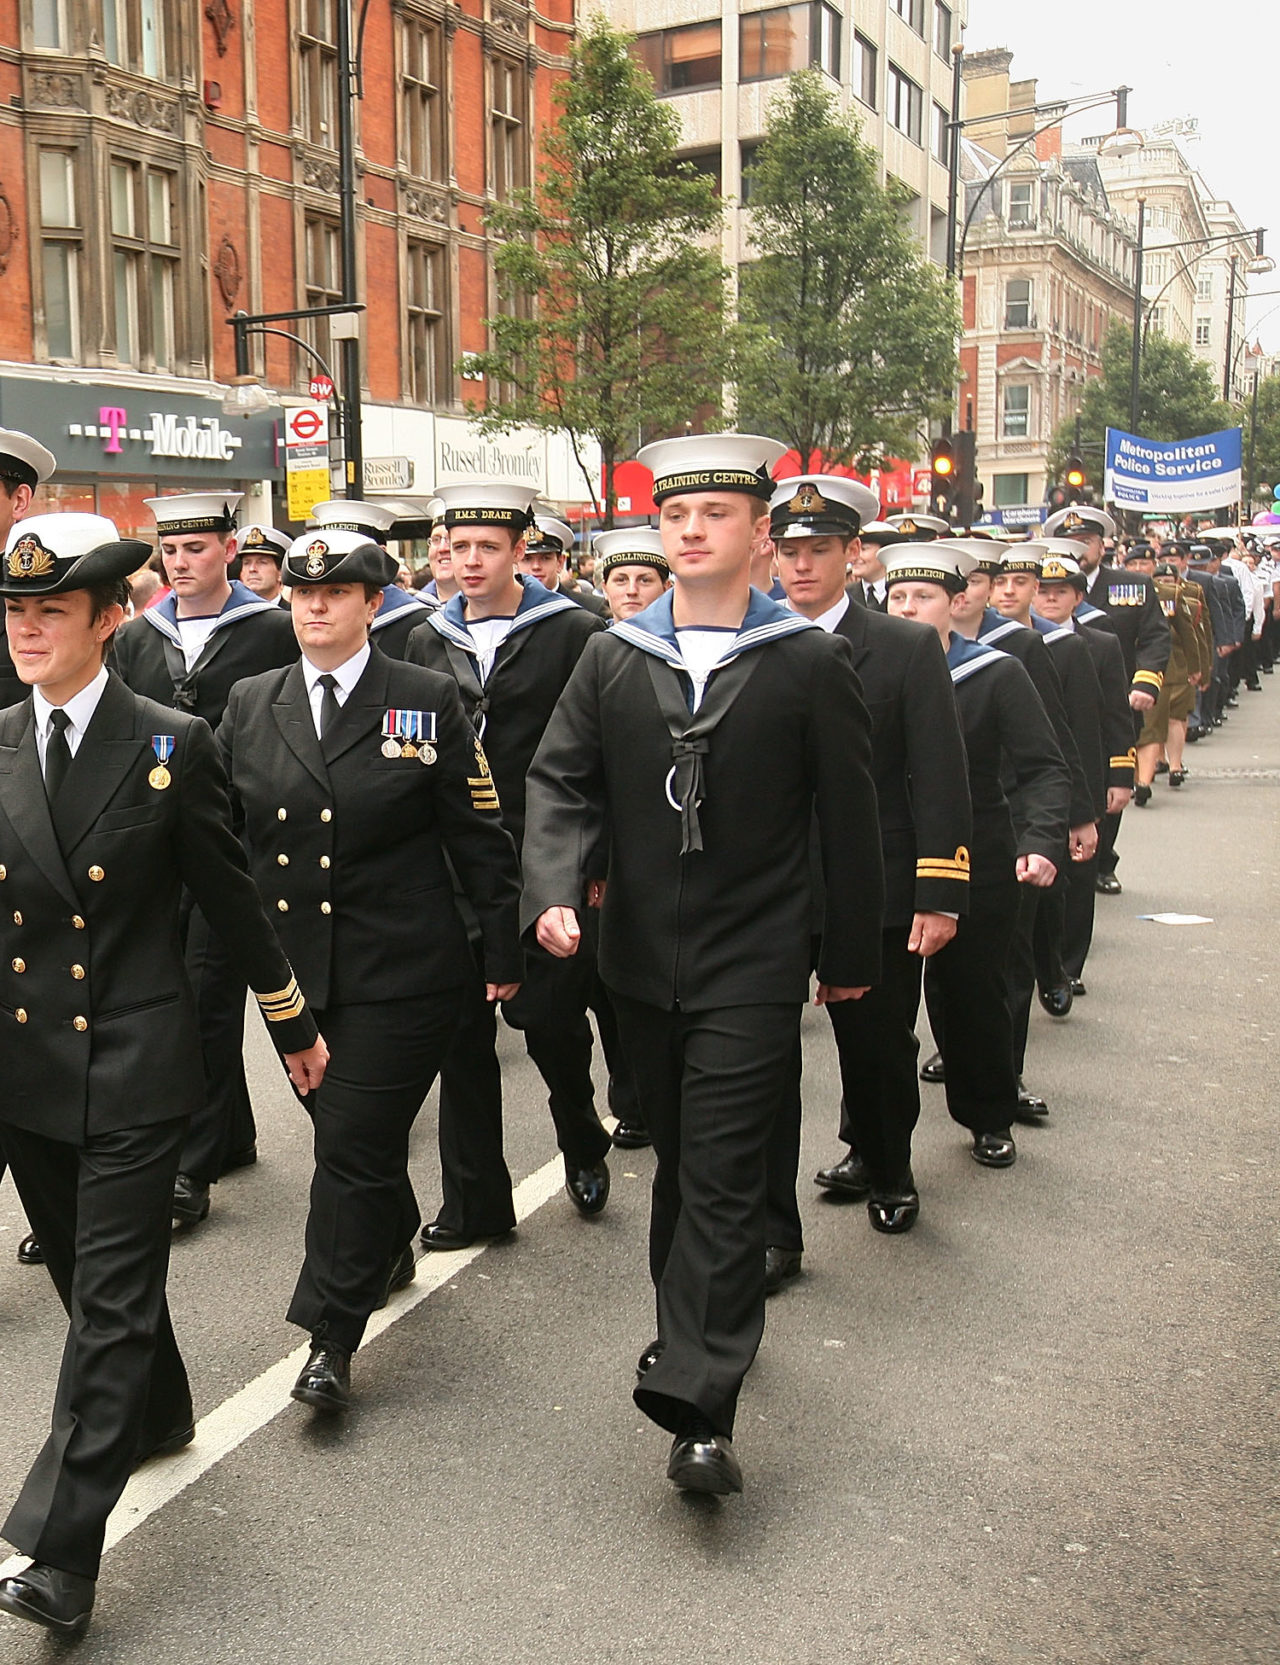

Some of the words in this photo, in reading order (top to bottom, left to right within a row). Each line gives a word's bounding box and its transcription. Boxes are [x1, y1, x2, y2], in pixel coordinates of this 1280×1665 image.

[310, 382, 332, 396] BW
[1119, 439, 1216, 463] Metropolitan
[364, 460, 401, 474] Russell
[440, 441, 487, 472] Russell
[493, 446, 542, 483] Bromley
[1114, 453, 1151, 475] Police
[1154, 457, 1223, 476] Service
[364, 473, 406, 488] Bromley
[658, 472, 710, 491] TRAINING
[712, 472, 759, 485] CENTRE
[481, 510, 513, 520] DRAKE
[181, 518, 215, 529] CENTRE
[325, 523, 359, 532] RALEIGH
[905, 569, 945, 580] RALEIGH
